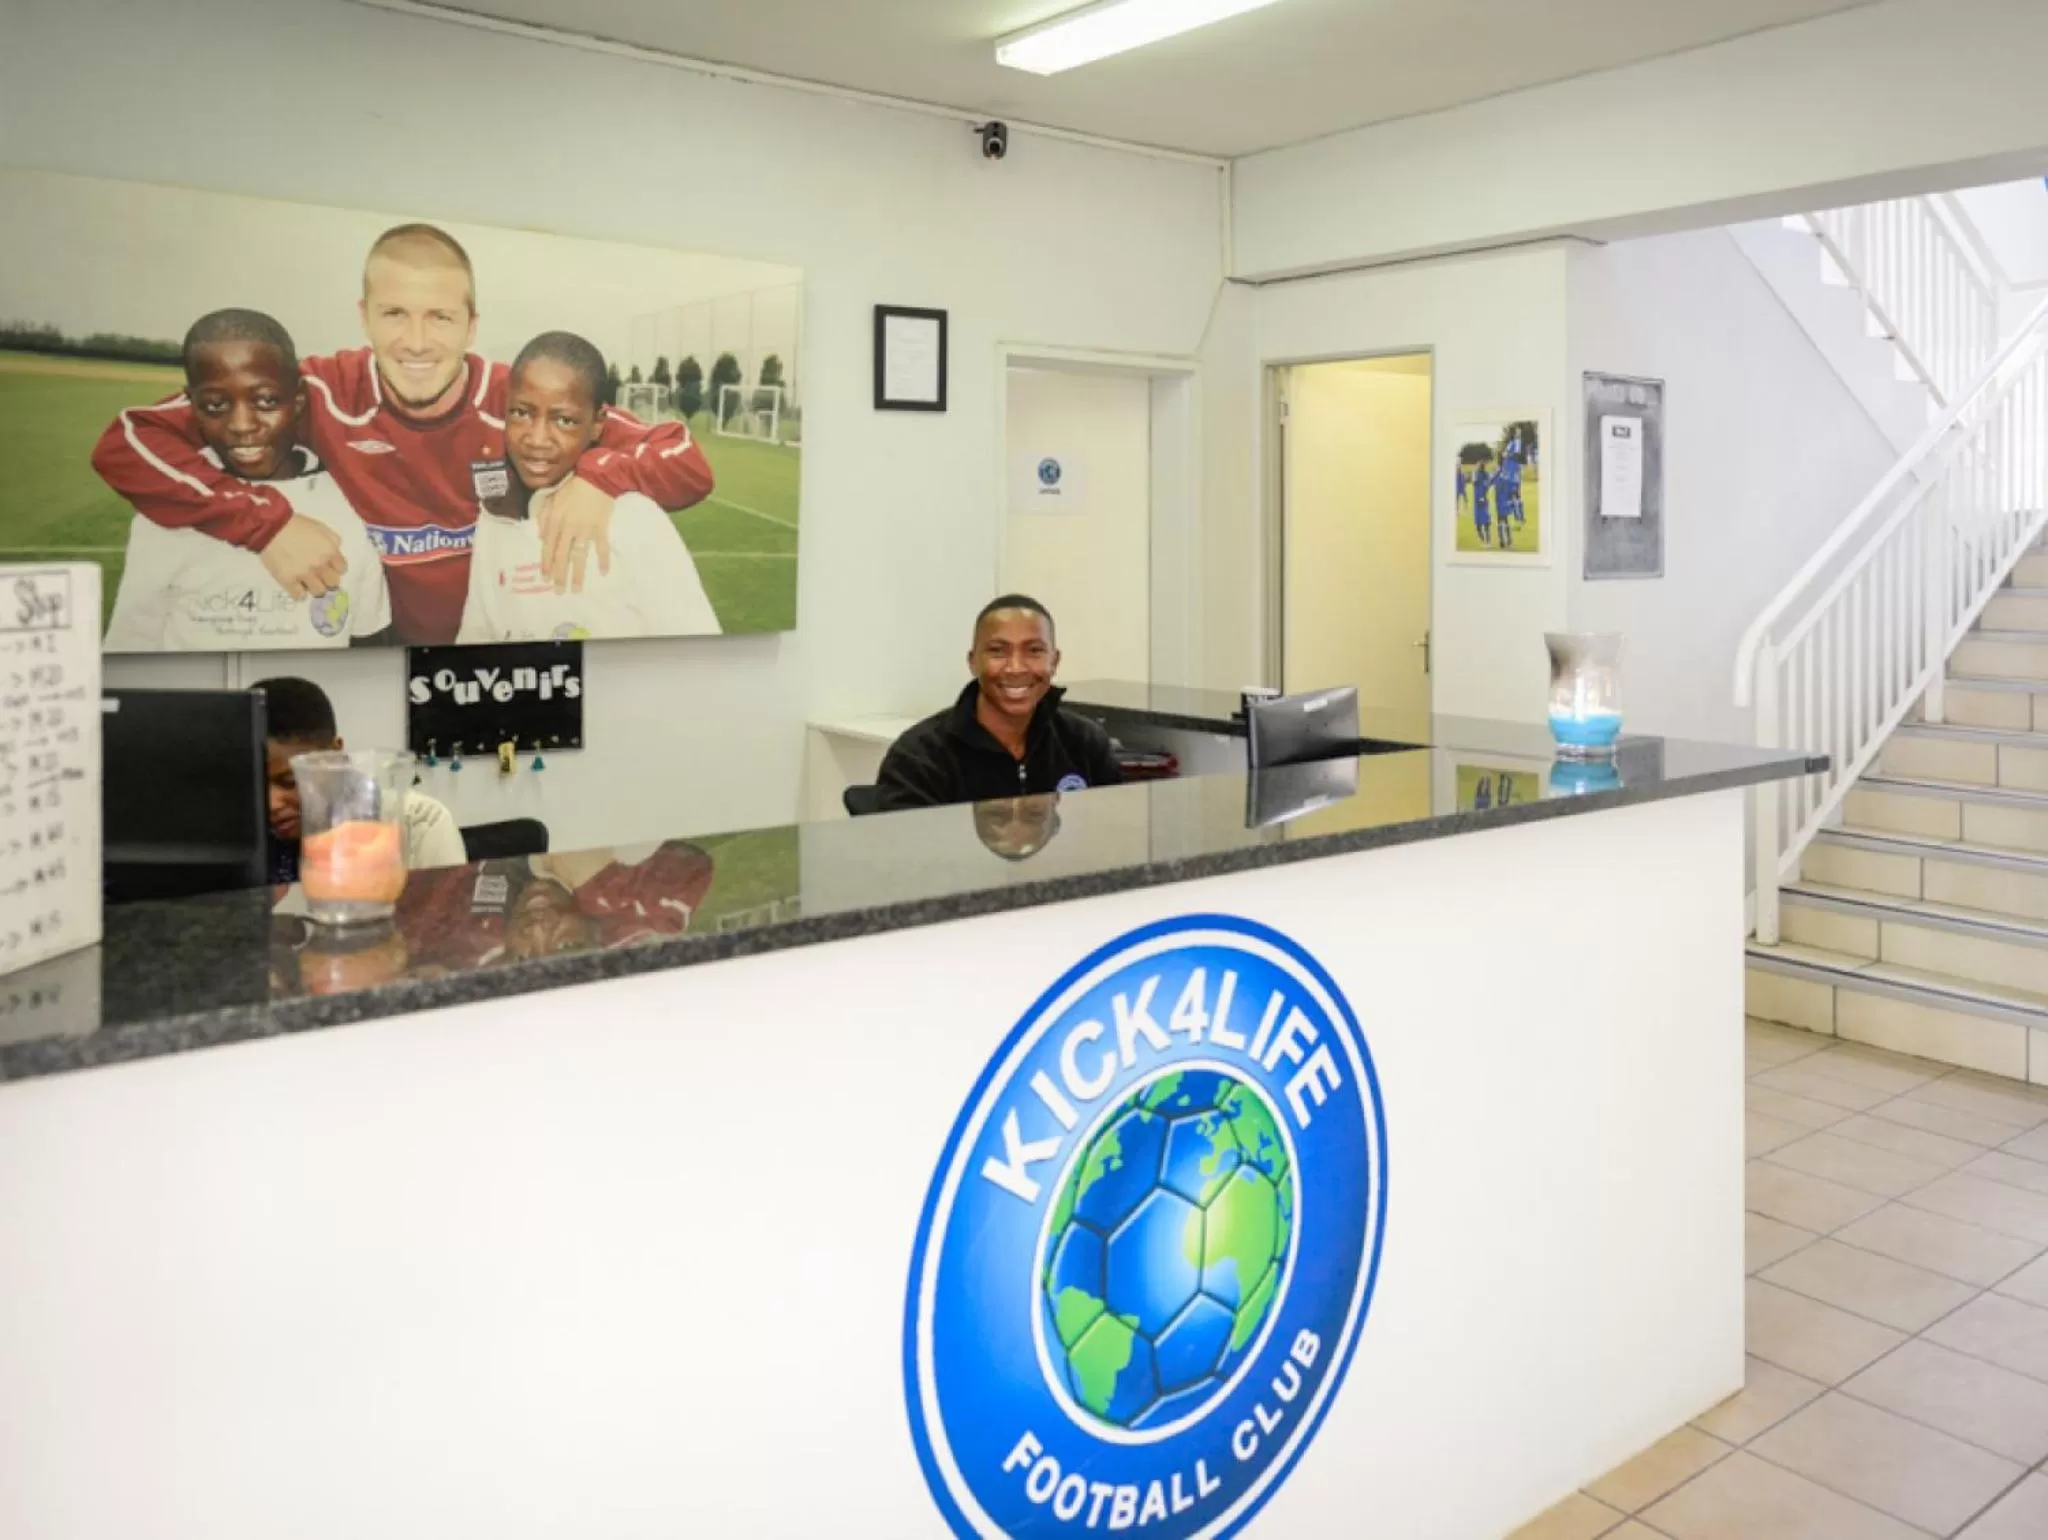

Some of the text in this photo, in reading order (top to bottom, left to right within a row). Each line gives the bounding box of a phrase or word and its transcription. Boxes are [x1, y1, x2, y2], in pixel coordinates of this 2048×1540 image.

[981, 967, 1342, 1205] KICK4LIFE
[1002, 1328, 1321, 1530] FOOTBALL CLUB
